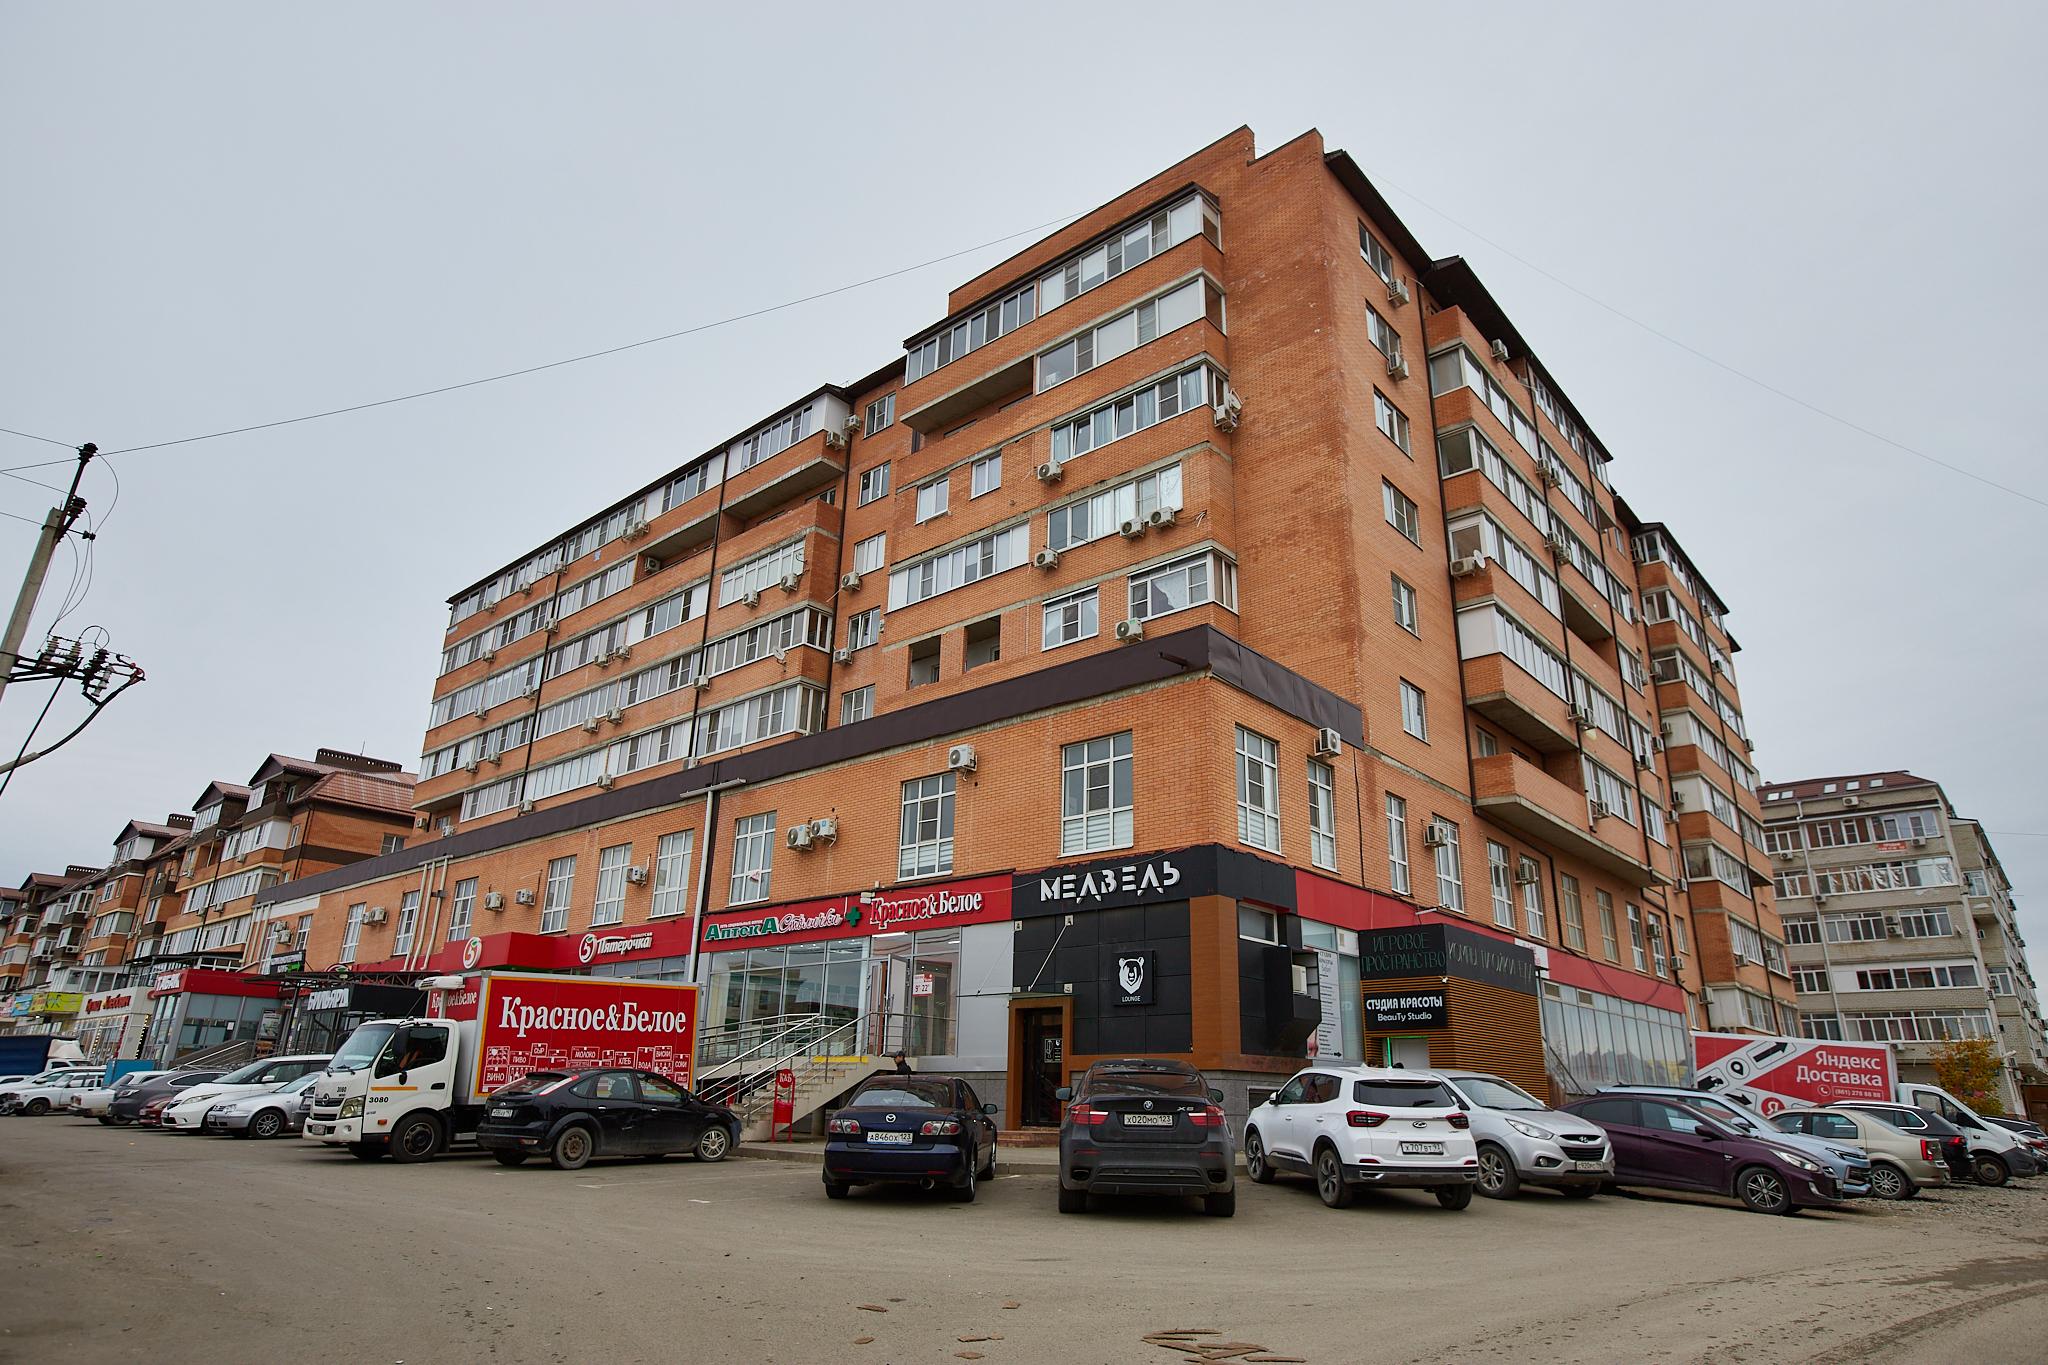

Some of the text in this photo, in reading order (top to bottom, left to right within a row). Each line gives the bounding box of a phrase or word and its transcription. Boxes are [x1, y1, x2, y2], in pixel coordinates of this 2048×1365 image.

[870, 890, 982, 929] Красное&Белое
[597, 936, 653, 955] Пятерочка
[1373, 933, 1430, 953] ИГРОВОЕ
[1362, 951, 1446, 972] ПРОСТРАНСТВО
[307, 988, 350, 1011] БИЛЬЯРД
[1121, 995, 1141, 1003] LOUNGE
[1366, 996, 1442, 1011] СТУДИЯ КРАСОТЫ
[499, 996, 686, 1037] Красное&Белое
[1408, 1012, 1432, 1021] Studio
[575, 1051, 596, 1059] МОЛОКО
[618, 1057, 632, 1065] ХЛЕБ
[655, 1050, 671, 1058] ВИСКИ
[1815, 1050, 1881, 1070] Яндекс
[638, 1061, 652, 1070] ВОДА
[486, 1073, 505, 1082] ВИНО
[1796, 1065, 1883, 1087] Доставка
[368, 1096, 389, 1104] 3080
